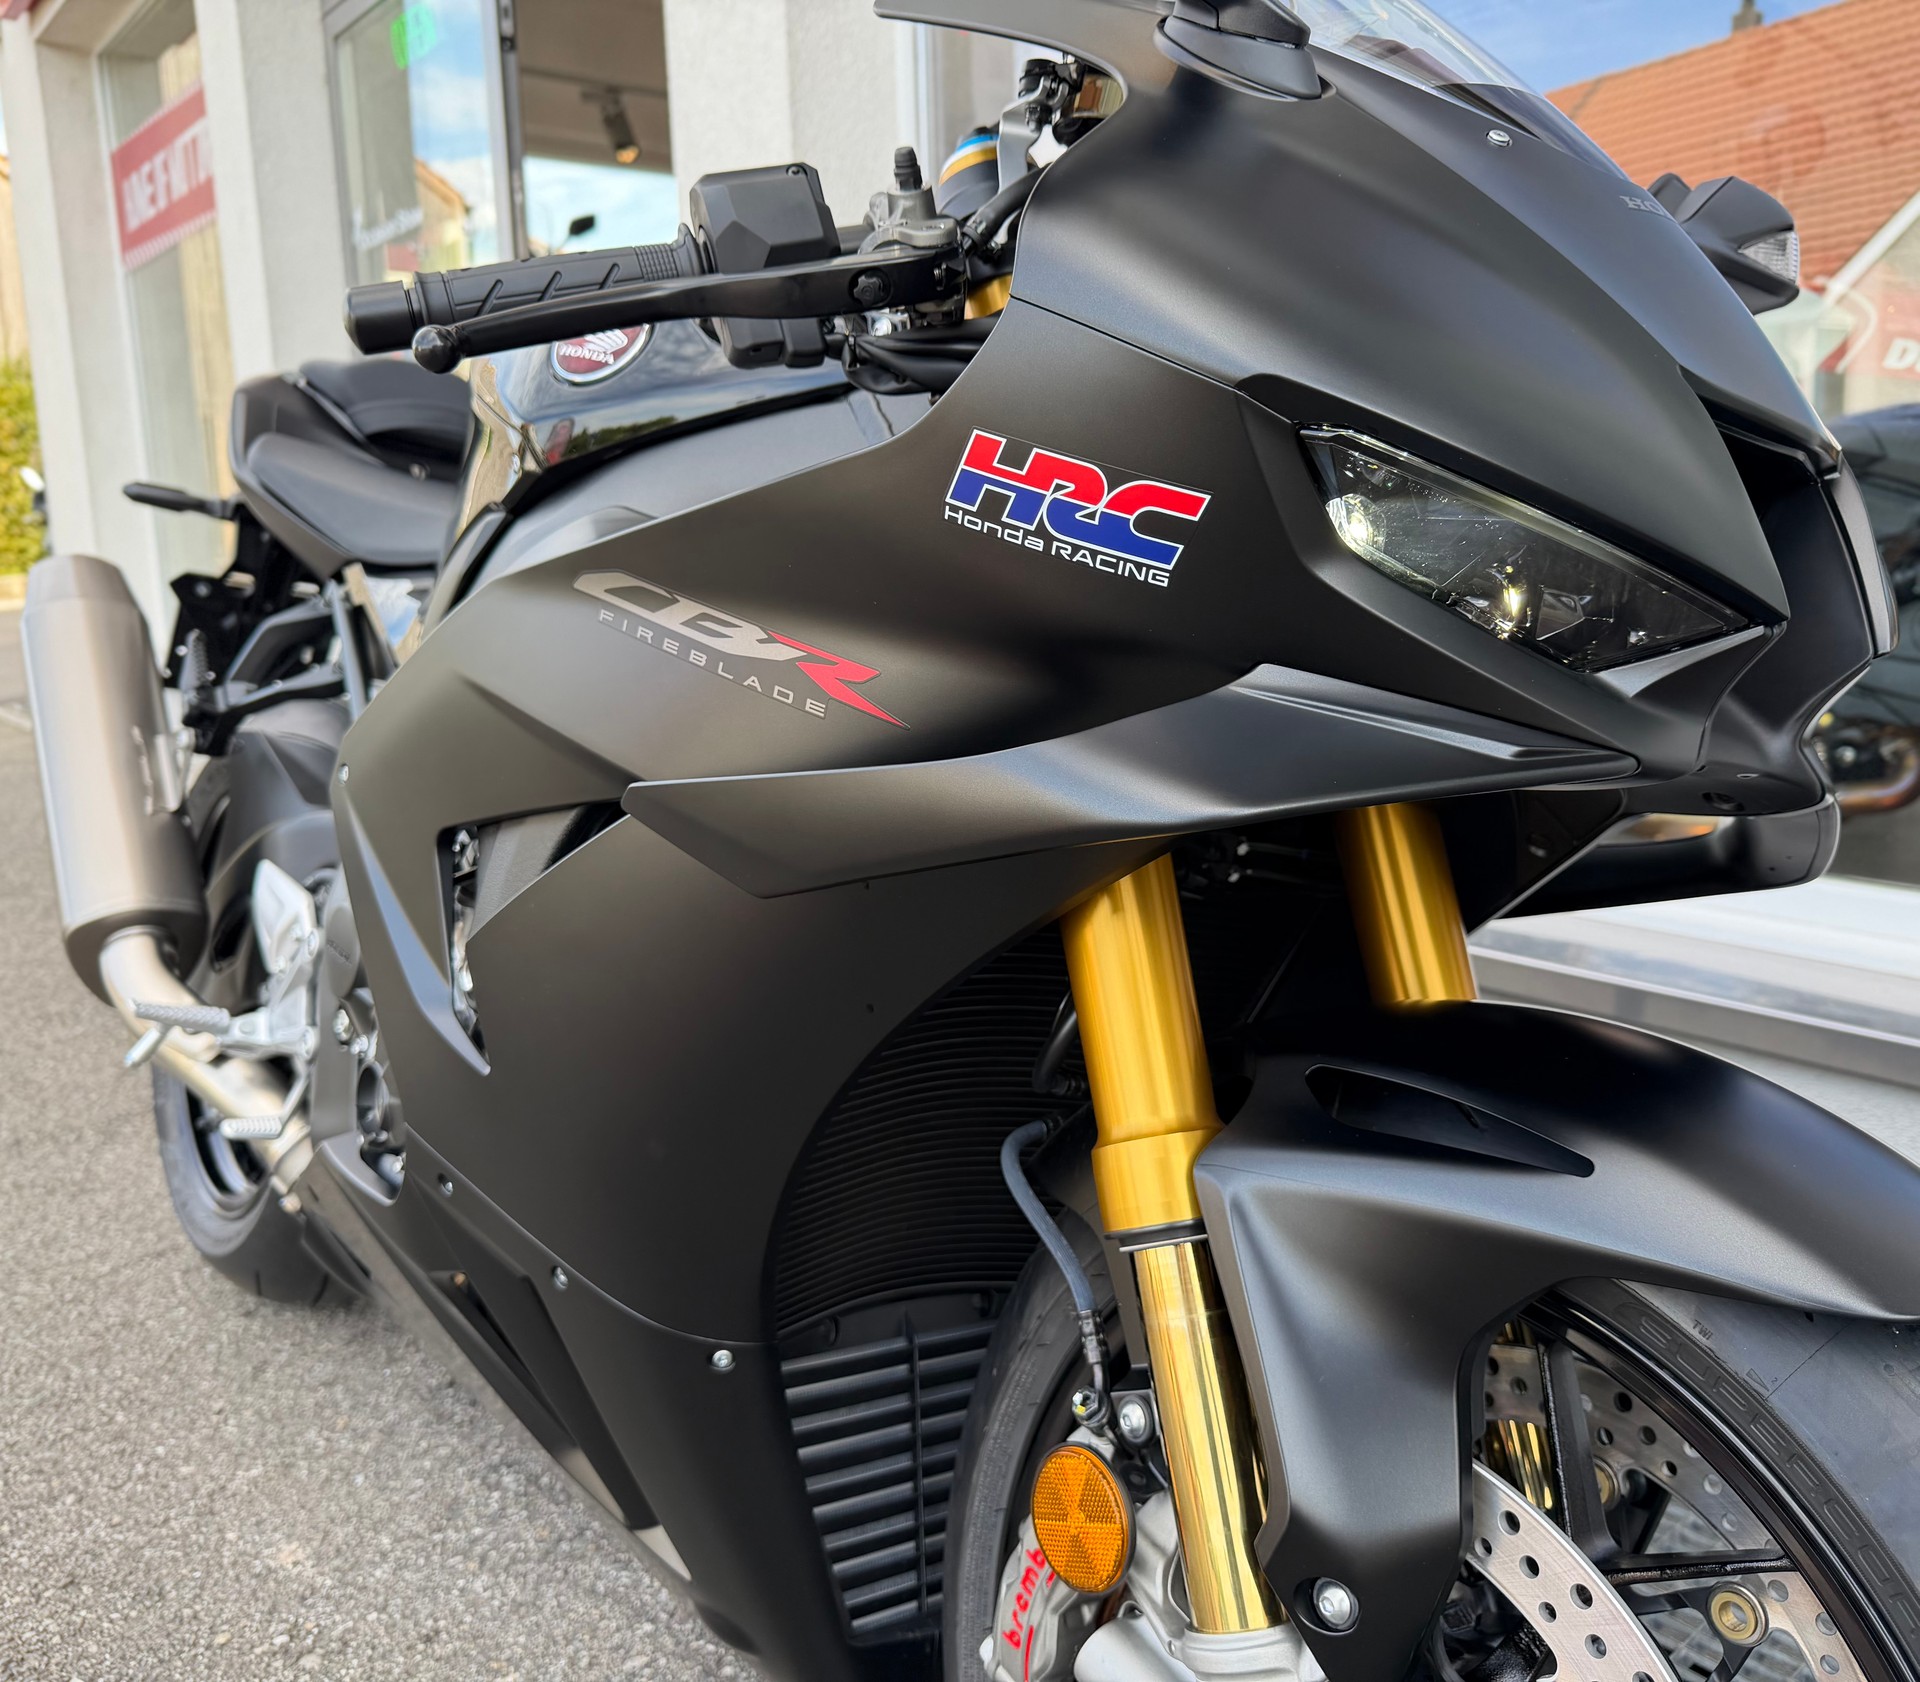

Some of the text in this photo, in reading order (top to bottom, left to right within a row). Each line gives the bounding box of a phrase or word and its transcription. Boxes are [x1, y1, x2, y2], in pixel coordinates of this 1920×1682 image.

[560, 343, 615, 365] HONDA
[944, 505, 1170, 588] Honda RACING
[945, 429, 1211, 570] HRC
[573, 571, 908, 729] CBR
[599, 608, 827, 718] FIREBLADE
[1691, 1319, 1714, 1341] TWI
[1639, 1315, 1920, 1640] SUPERCOR
[1002, 1548, 1047, 1650] bremb
